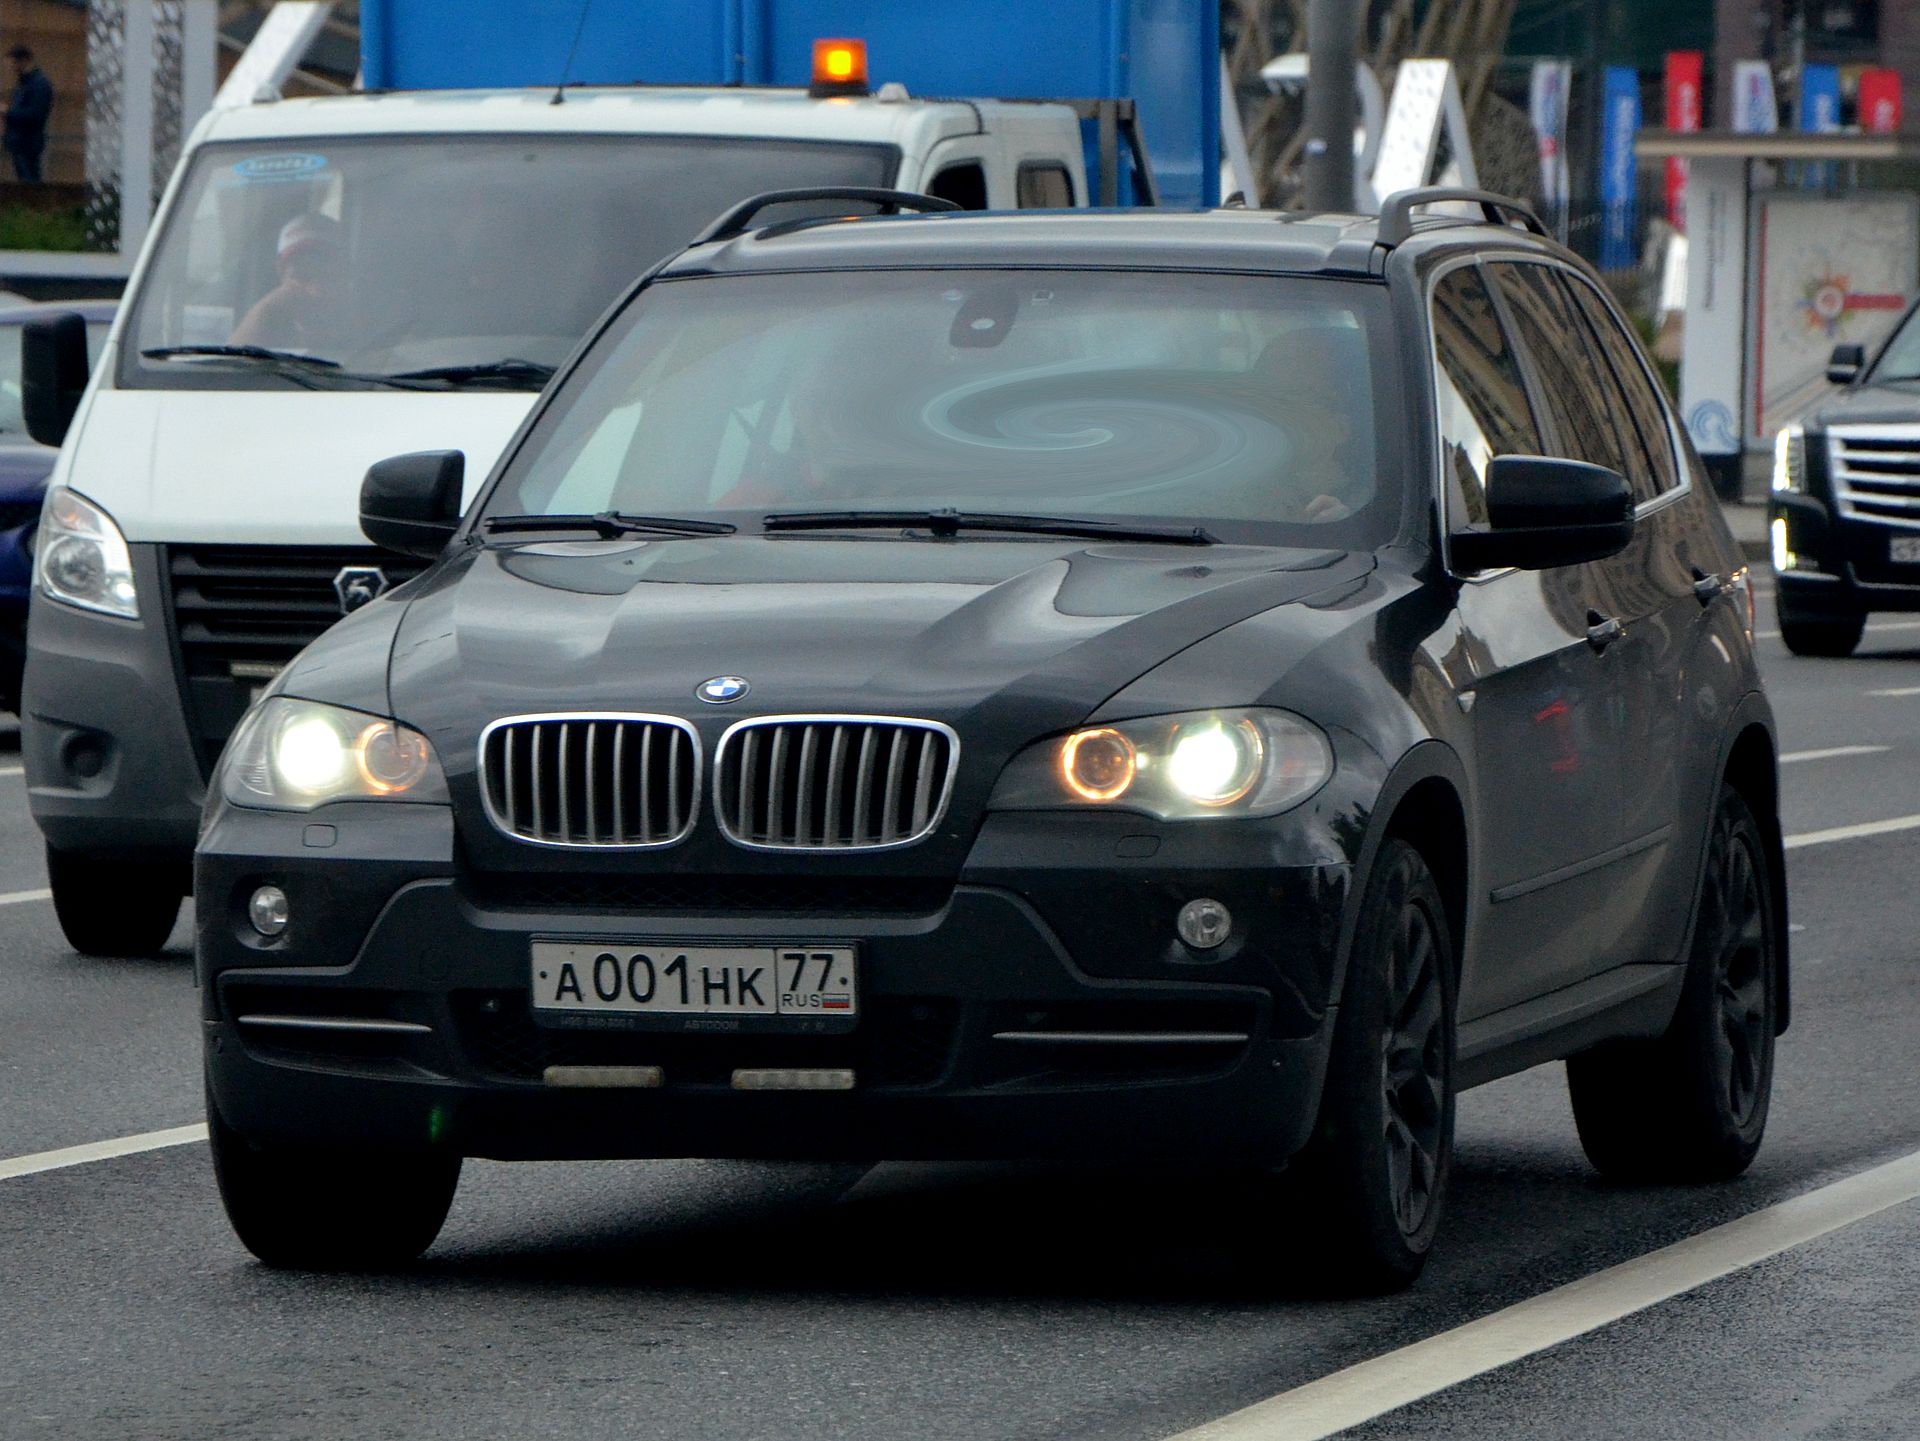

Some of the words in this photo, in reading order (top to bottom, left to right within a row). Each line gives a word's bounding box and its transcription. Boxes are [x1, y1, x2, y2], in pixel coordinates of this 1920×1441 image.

[554, 952, 766, 1007] A001HK
[783, 953, 835, 992] 77
[781, 993, 821, 1008] RUS
